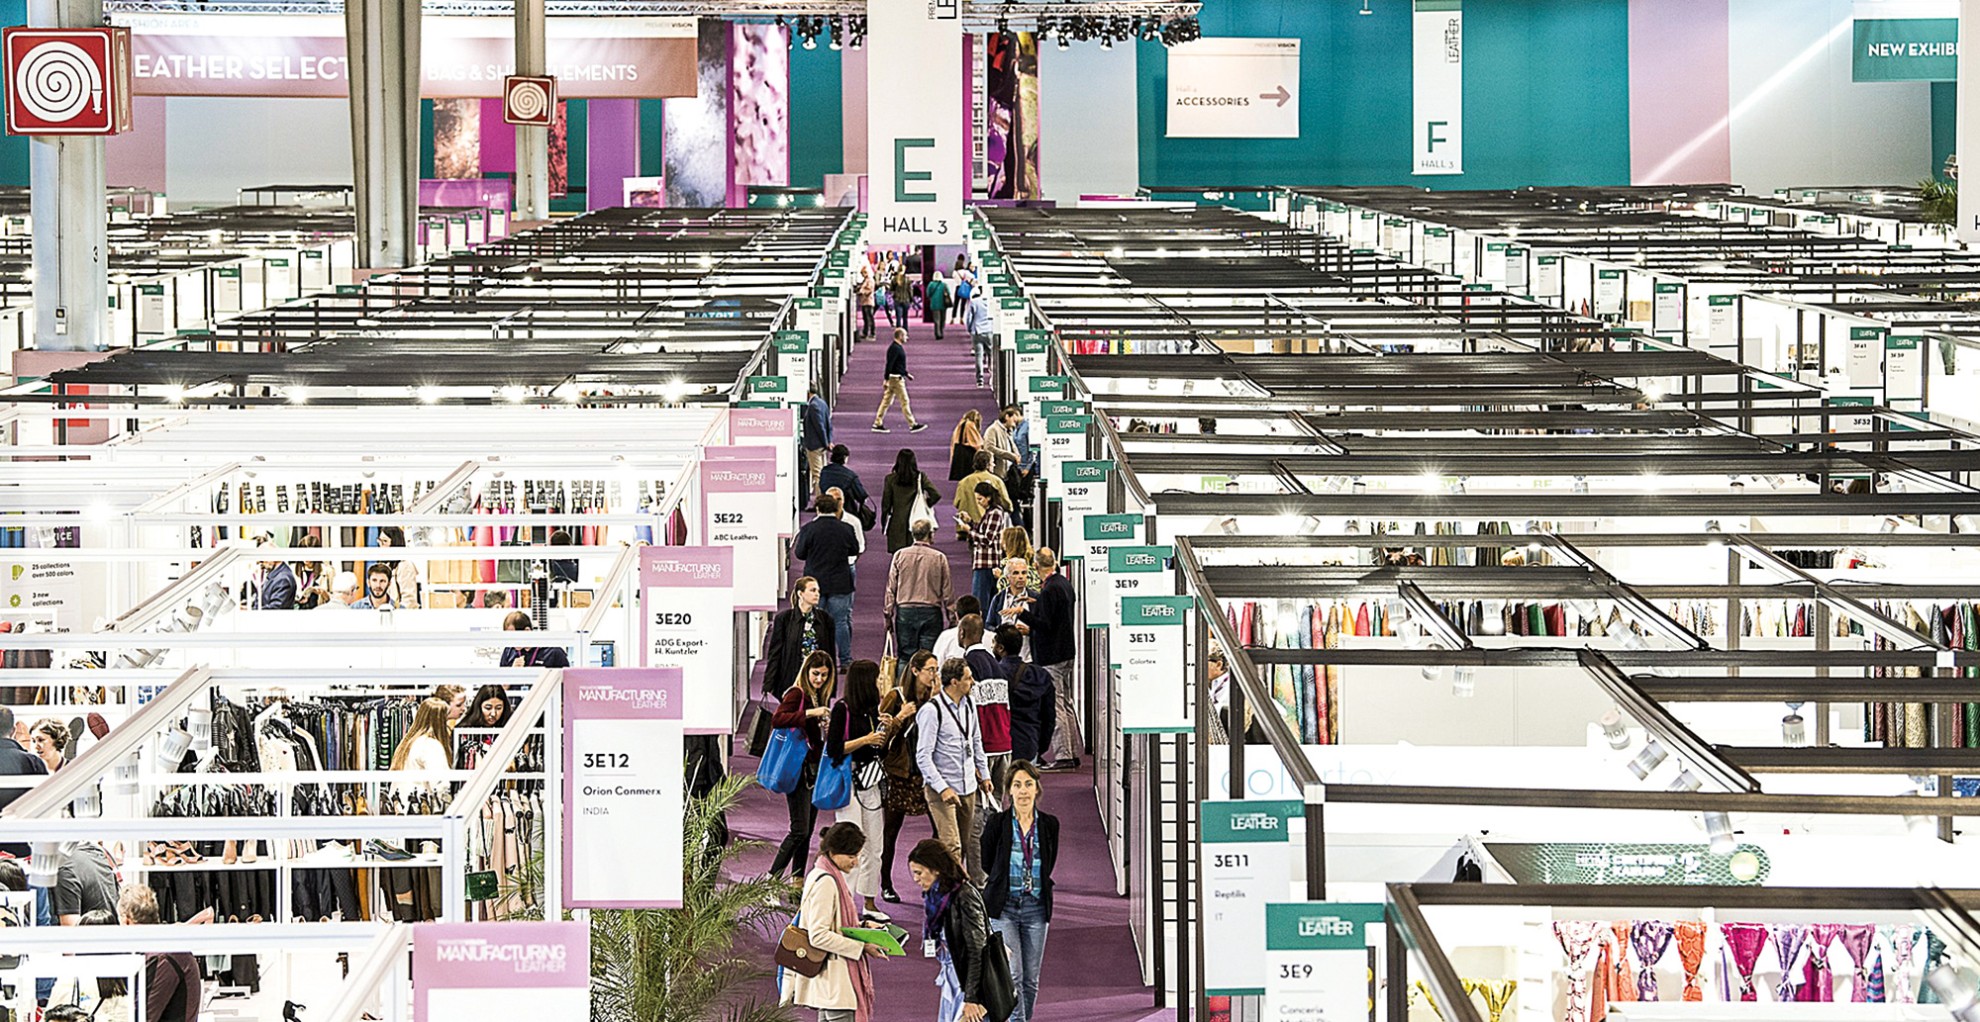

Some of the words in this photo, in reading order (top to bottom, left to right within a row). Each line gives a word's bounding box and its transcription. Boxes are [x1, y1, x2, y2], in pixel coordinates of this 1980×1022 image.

[1448, 18, 1459, 63] LEATHER
[1868, 43, 1905, 56] NEW
[132, 55, 243, 79] EATHER
[468, 65, 483, 80] &
[486, 65, 516, 80] SH
[556, 65, 637, 80] LEMENTS
[1176, 97, 1250, 106] ACCESSORIES
[1428, 121, 1448, 153] F
[1421, 160, 1446, 168] HALL
[1449, 161, 1454, 169] 3
[894, 138, 936, 203] E
[883, 217, 933, 232] HALL
[938, 220, 948, 234] 3
[1068, 488, 1088, 496] 3E29
[714, 513, 743, 523] 3E22
[1101, 524, 1128, 532] LEATHER
[1090, 546, 1108, 555] 3E2
[1126, 556, 1155, 565] LEATHER
[652, 563, 721, 572] MANUFACTURING
[1115, 580, 1139, 588] 3E19
[1142, 607, 1175, 616] LEATHER
[655, 613, 692, 624] 3E20
[676, 638, 703, 647] Export
[1129, 634, 1156, 642] 3E13
[579, 689, 667, 700] MANUFACTURING
[632, 700, 667, 708] LEATHER
[584, 754, 629, 768] 3E12
[583, 786, 613, 796] Orion
[615, 786, 661, 796] Conmerx
[1231, 818, 1278, 830] LEATHER
[1214, 855, 1248, 867] 3E11
[1298, 921, 1354, 936] LEATHER
[437, 944, 566, 961] MANUFACTURING
[514, 960, 566, 973] LEATHER
[1280, 964, 1312, 979] 3E9
[1280, 1004, 1324, 1014] Conceria
